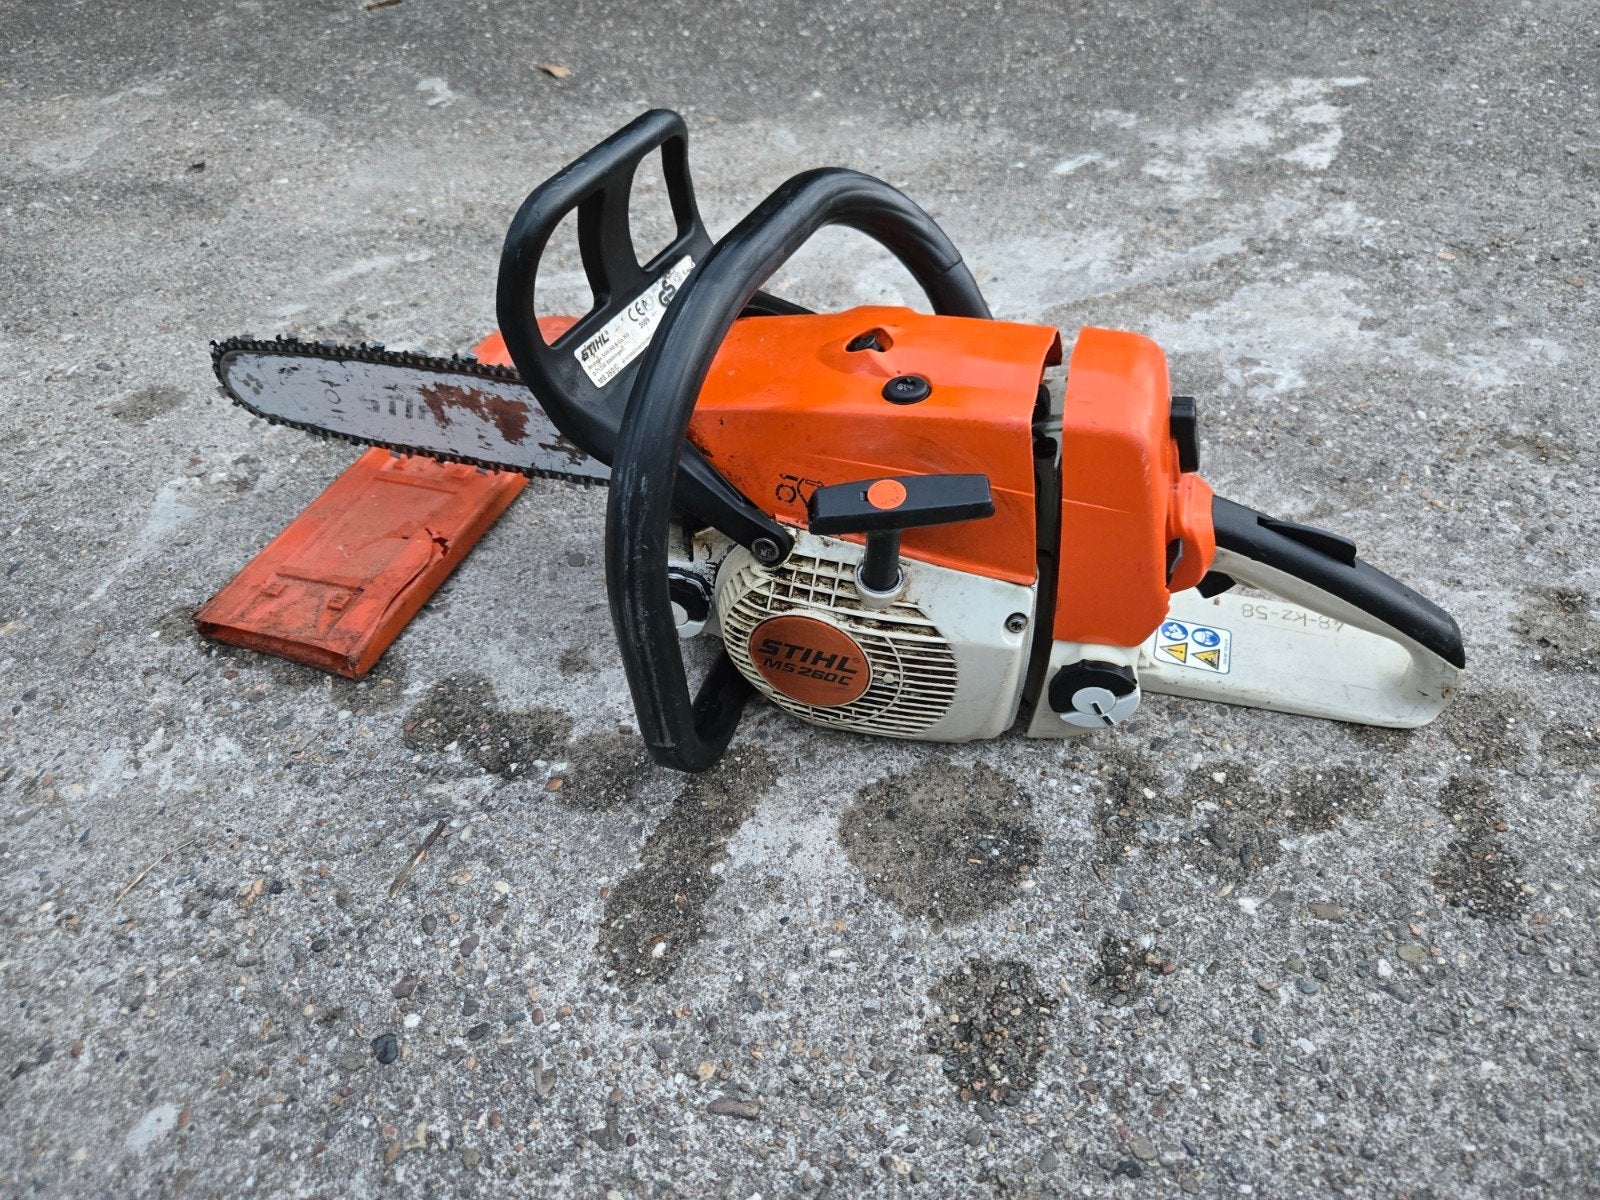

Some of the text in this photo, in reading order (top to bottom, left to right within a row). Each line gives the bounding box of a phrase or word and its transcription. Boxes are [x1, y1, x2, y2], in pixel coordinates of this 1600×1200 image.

[581, 333, 610, 361] STIHL
[758, 638, 858, 675] STIHL
[763, 656, 797, 673] MS
